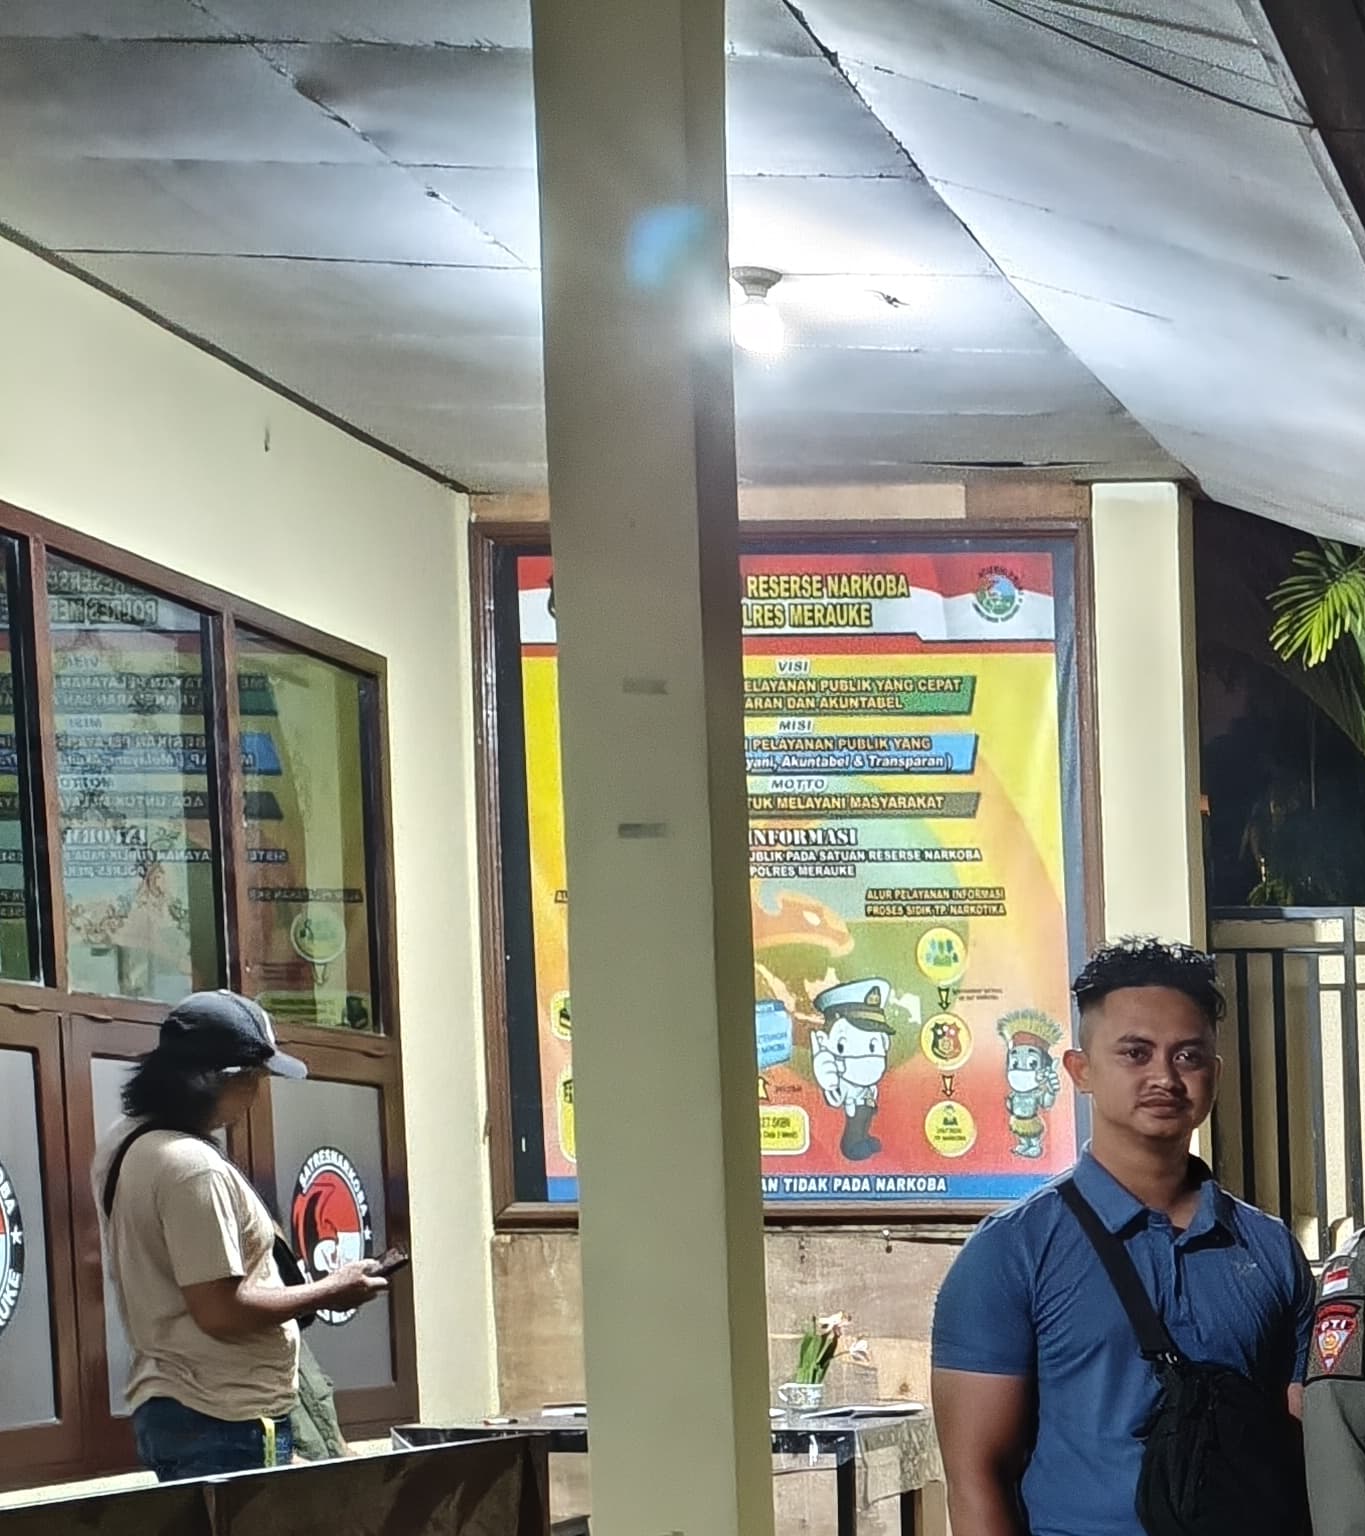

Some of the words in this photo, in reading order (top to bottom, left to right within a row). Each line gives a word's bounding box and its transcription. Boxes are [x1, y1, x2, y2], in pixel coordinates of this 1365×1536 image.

[746, 575, 823, 598] RESERSE
[827, 574, 910, 598] NARKOBA
[741, 603, 785, 627] LRES
[789, 603, 872, 627] MERAUKE
[778, 660, 809, 673] VISI
[744, 679, 817, 692] ELAYANAN
[820, 679, 872, 692] PUBLIK
[875, 679, 914, 692] YANG
[918, 679, 962, 692] CEPAT
[744, 697, 783, 710] ARAN
[786, 697, 816, 710] DAN
[819, 696, 904, 709] AKUNTABEL
[778, 719, 813, 731] MISI
[752, 738, 834, 750] PELAYANAN
[838, 738, 891, 750] PUBLIK
[893, 738, 932, 750] YANG
[745, 757, 778, 771] yani,
[781, 755, 849, 768] Akuntabel
[853, 756, 864, 768] &
[868, 755, 944, 772] Transparan
[770, 778, 826, 790] MOTTO
[748, 796, 774, 810] TUK
[776, 796, 846, 810] MELAYANI
[850, 796, 944, 810] MASYARAKAT
[748, 828, 857, 846] INFORMASI
[750, 851, 784, 862] UBLIK
[786, 850, 817, 862] PADA
[820, 850, 866, 862] SATUAN
[869, 850, 922, 862] RESERSE
[925, 849, 982, 861] NARKOBA
[750, 866, 796, 878] POLRES
[798, 866, 855, 877] MERAUKE
[866, 888, 894, 900] ALUR
[894, 888, 950, 900] PELAYANAN
[952, 888, 1006, 900] INFORMASI
[866, 905, 904, 916] PROSES
[906, 904, 932, 916] SIDIK
[949, 903, 1006, 915] NARKOTIKA
[783, 1177, 828, 1192] TIDAK
[833, 1177, 871, 1192] PADA
[875, 1177, 947, 1192] NARKOBA
